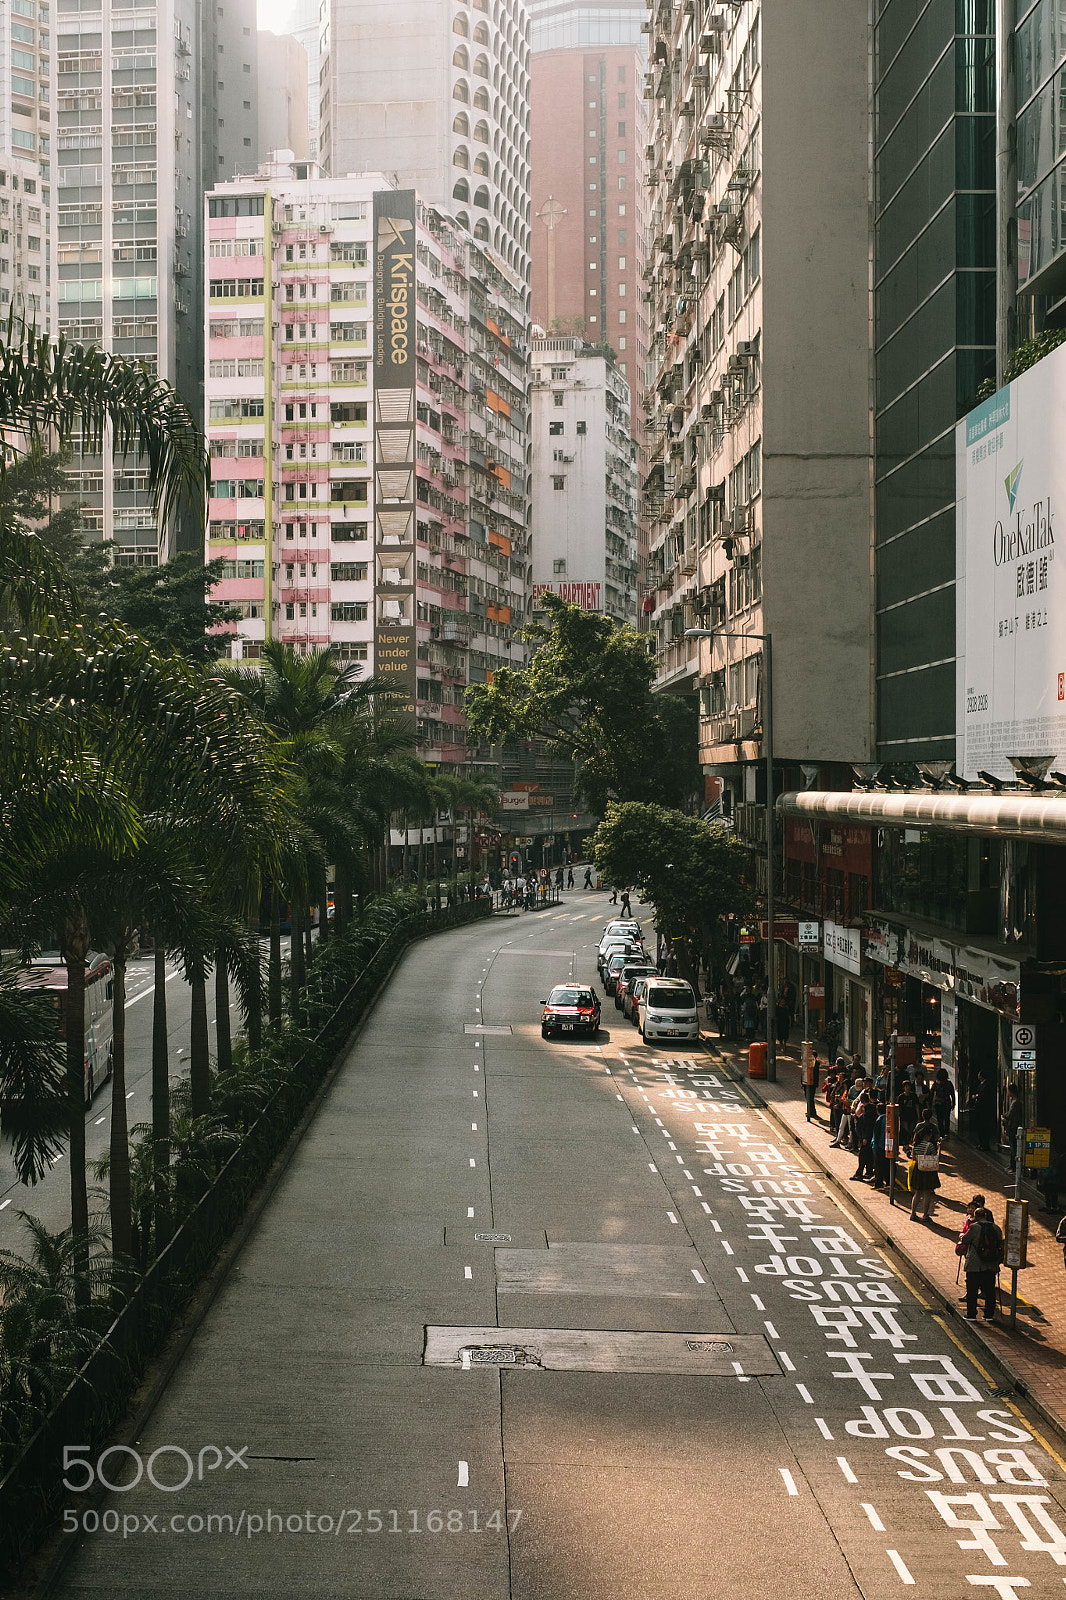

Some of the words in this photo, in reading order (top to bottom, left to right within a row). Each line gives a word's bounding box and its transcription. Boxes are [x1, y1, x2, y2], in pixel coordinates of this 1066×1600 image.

[386, 253, 413, 365] Krispace
[559, 582, 601, 610] APARTMENT
[378, 634, 410, 644] Never
[378, 648, 410, 657] under
[378, 661, 408, 671] value
[658, 1088, 741, 1100] STOP
[672, 1101, 745, 1113] BUS
[703, 1162, 806, 1178] STOP
[719, 1178, 813, 1195] BUS
[754, 1254, 895, 1279] STOP
[781, 1279, 902, 1304] BUS
[844, 1405, 1035, 1443] STOP
[884, 1445, 1050, 1488] BUS
